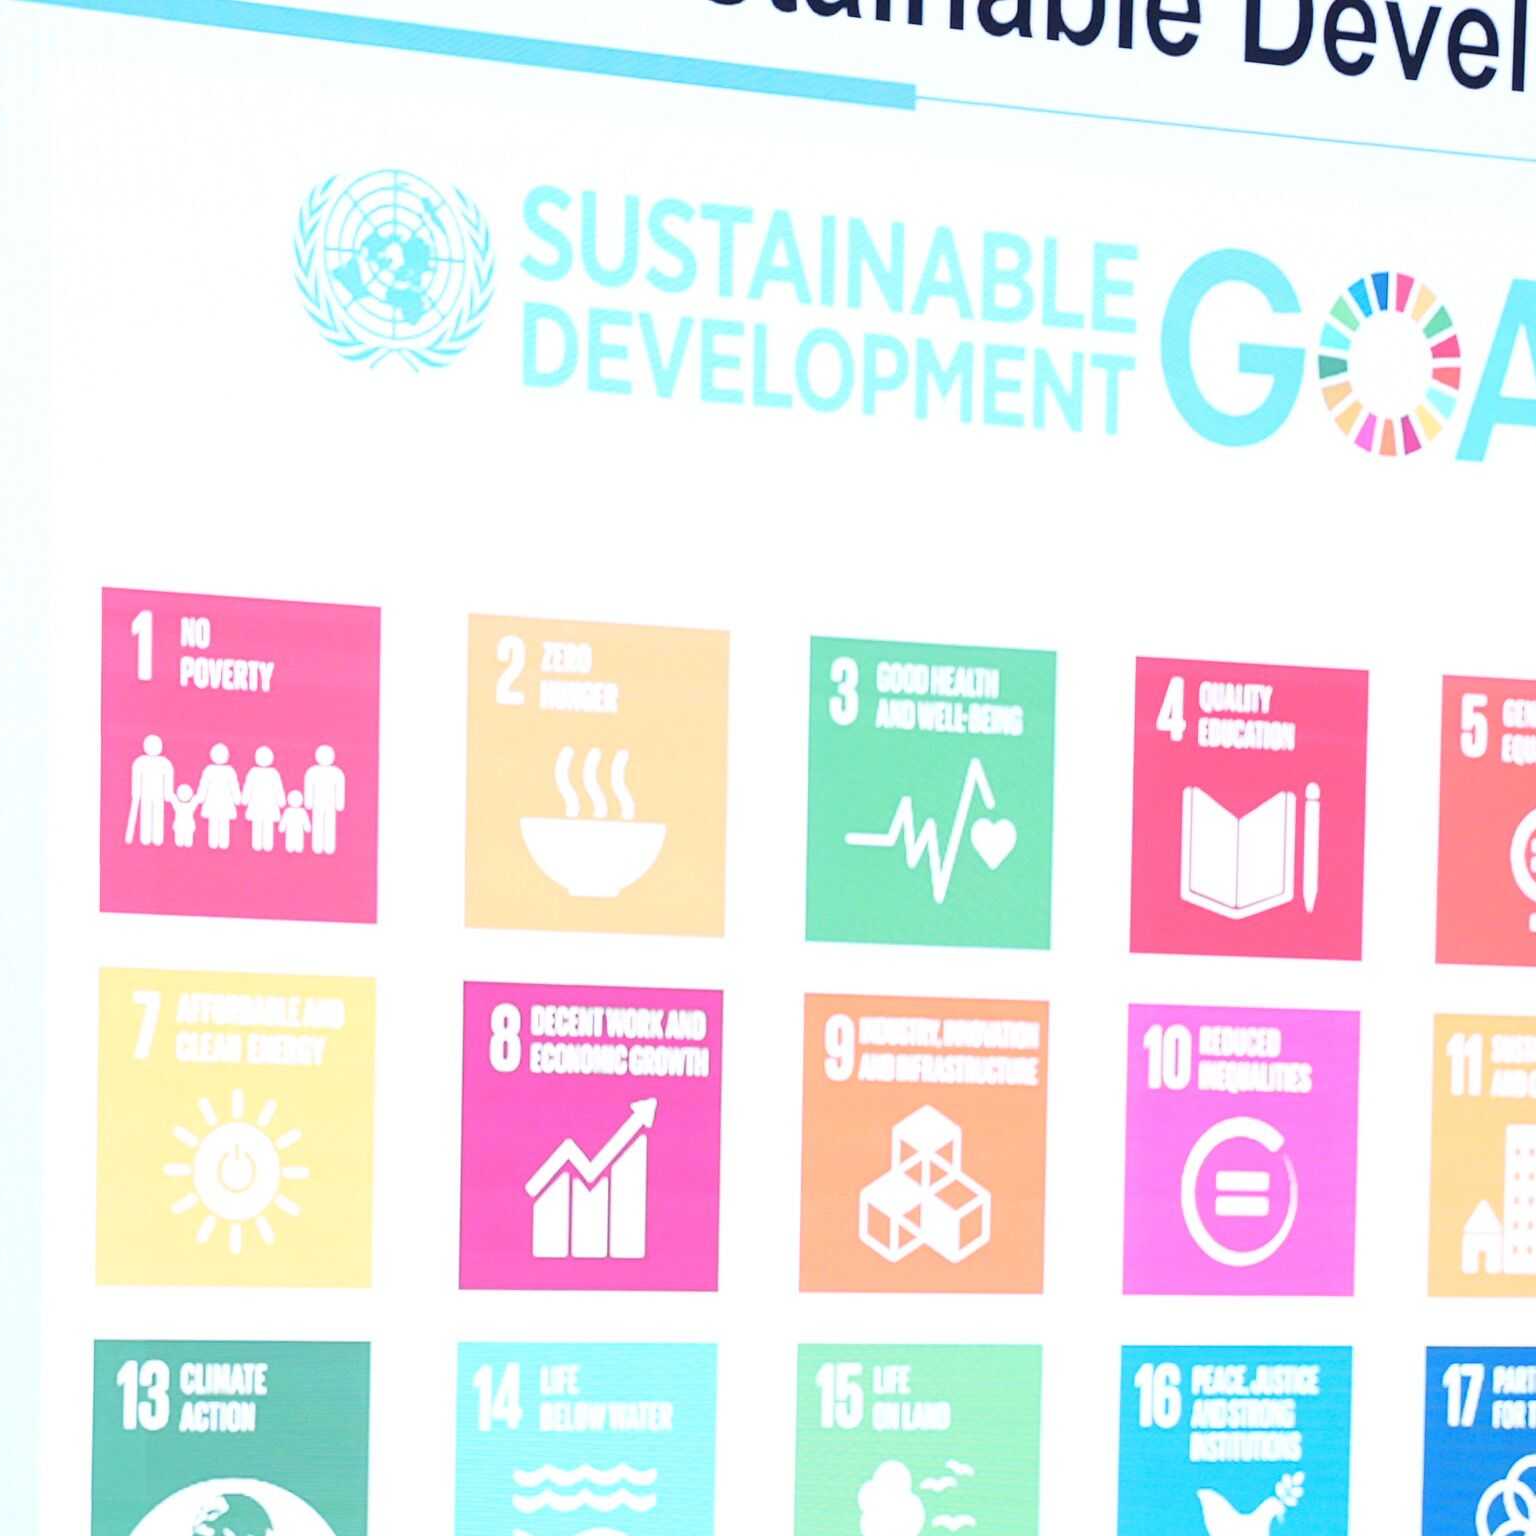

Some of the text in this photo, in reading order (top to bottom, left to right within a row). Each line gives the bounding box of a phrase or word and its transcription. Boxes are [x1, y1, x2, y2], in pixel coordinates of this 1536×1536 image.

[520, 188, 1138, 333] SUSTAINABLE
[521, 303, 1138, 436] DEVELOPMENT
[132, 609, 152, 680] 1
[181, 617, 211, 649] NO
[180, 656, 274, 692] POVERTY
[496, 635, 525, 705] 2
[829, 656, 859, 725] 3
[877, 661, 1000, 699] GOOD HEALTH
[1199, 681, 1273, 714] QUALITY
[1156, 676, 1186, 741] 4
[1461, 692, 1488, 758] 5
[132, 990, 161, 1060] 7
[489, 1003, 521, 1073] 8
[530, 1004, 707, 1041] DECENT WORK AND
[824, 1013, 855, 1082] 9
[1143, 1023, 1192, 1090] 10
[1445, 1032, 1483, 1097] 11
[116, 1359, 170, 1431] 13
[179, 1362, 268, 1395] CLIMATE
[472, 1362, 522, 1431] 14
[815, 1362, 863, 1429] 15
[872, 1364, 912, 1394] LIFE
[1134, 1362, 1182, 1428] 16
[1443, 1363, 1484, 1427] 17
[178, 1402, 257, 1432] ACTION
